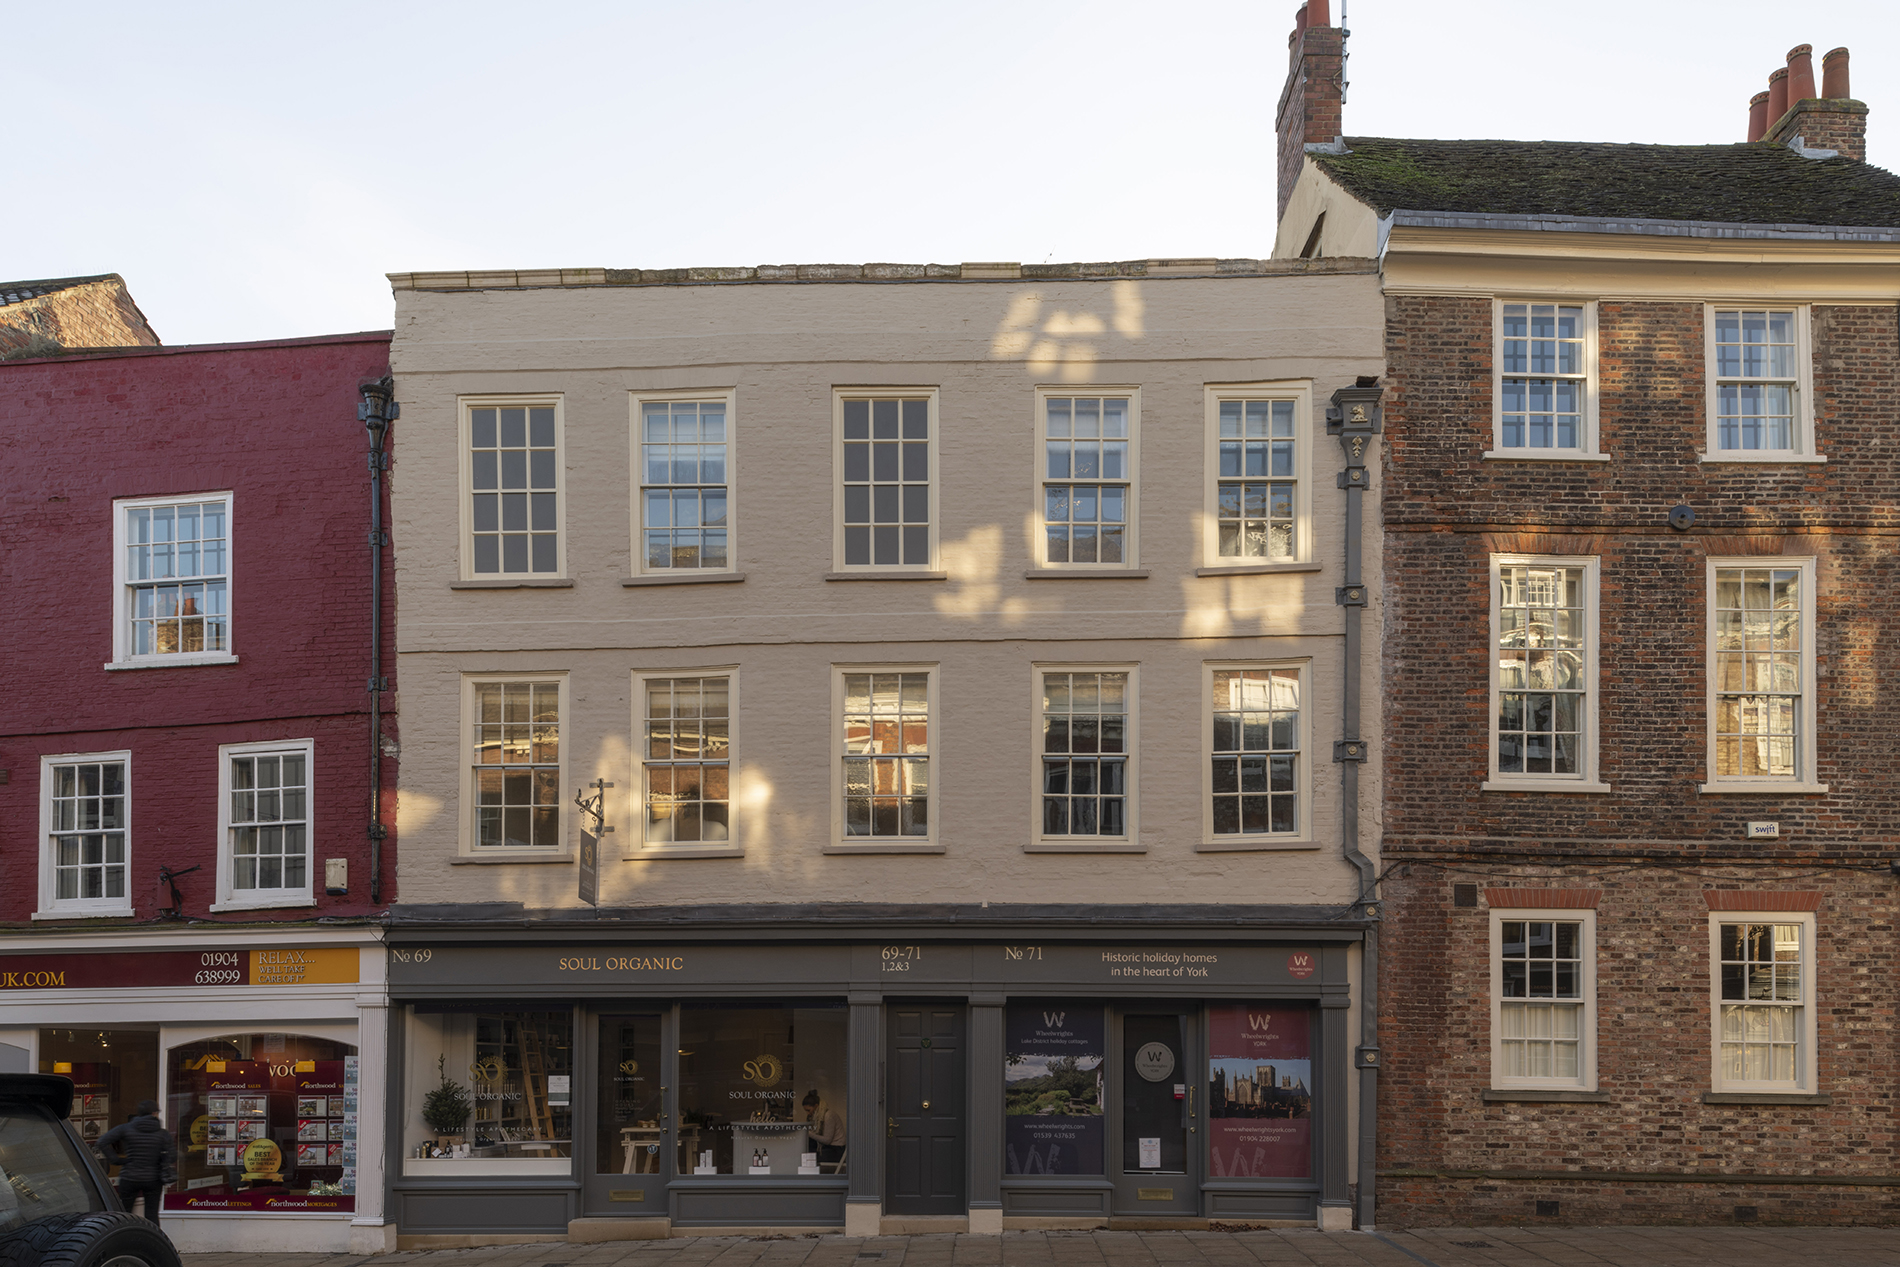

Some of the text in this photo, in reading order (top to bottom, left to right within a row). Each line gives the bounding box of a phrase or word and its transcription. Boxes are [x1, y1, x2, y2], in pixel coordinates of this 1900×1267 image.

[1755, 824, 1776, 834] swift
[259, 951, 316, 964] RELAX...
[414, 948, 432, 963] 69
[881, 946, 921, 960] 69-71
[1027, 946, 1043, 960] 71
[1101, 952, 1218, 965] Historic holiday homes
[201, 952, 239, 967] 01904
[559, 957, 683, 971] SOUL ORGANIC
[283, 965, 305, 973] TAKE
[881, 961, 910, 972] 1,2&3
[1111, 966, 1209, 977] in the heart of York
[194, 969, 241, 984] 638999
[258, 975, 282, 983] CARE
[282, 975, 296, 983] OF
[1035, 1030, 1074, 1038] Wheelwrights
[1241, 1033, 1280, 1041] Wheelwrights
[453, 1092, 522, 1101] SOUL ORGANIC
[728, 1090, 797, 1099] SOUL ORGANIC
[749, 1102, 776, 1123] hello
[1023, 1123, 1086, 1131] www.wheelwrights.com
[1223, 1126, 1297, 1134] www.wheelwrightsyork.com
